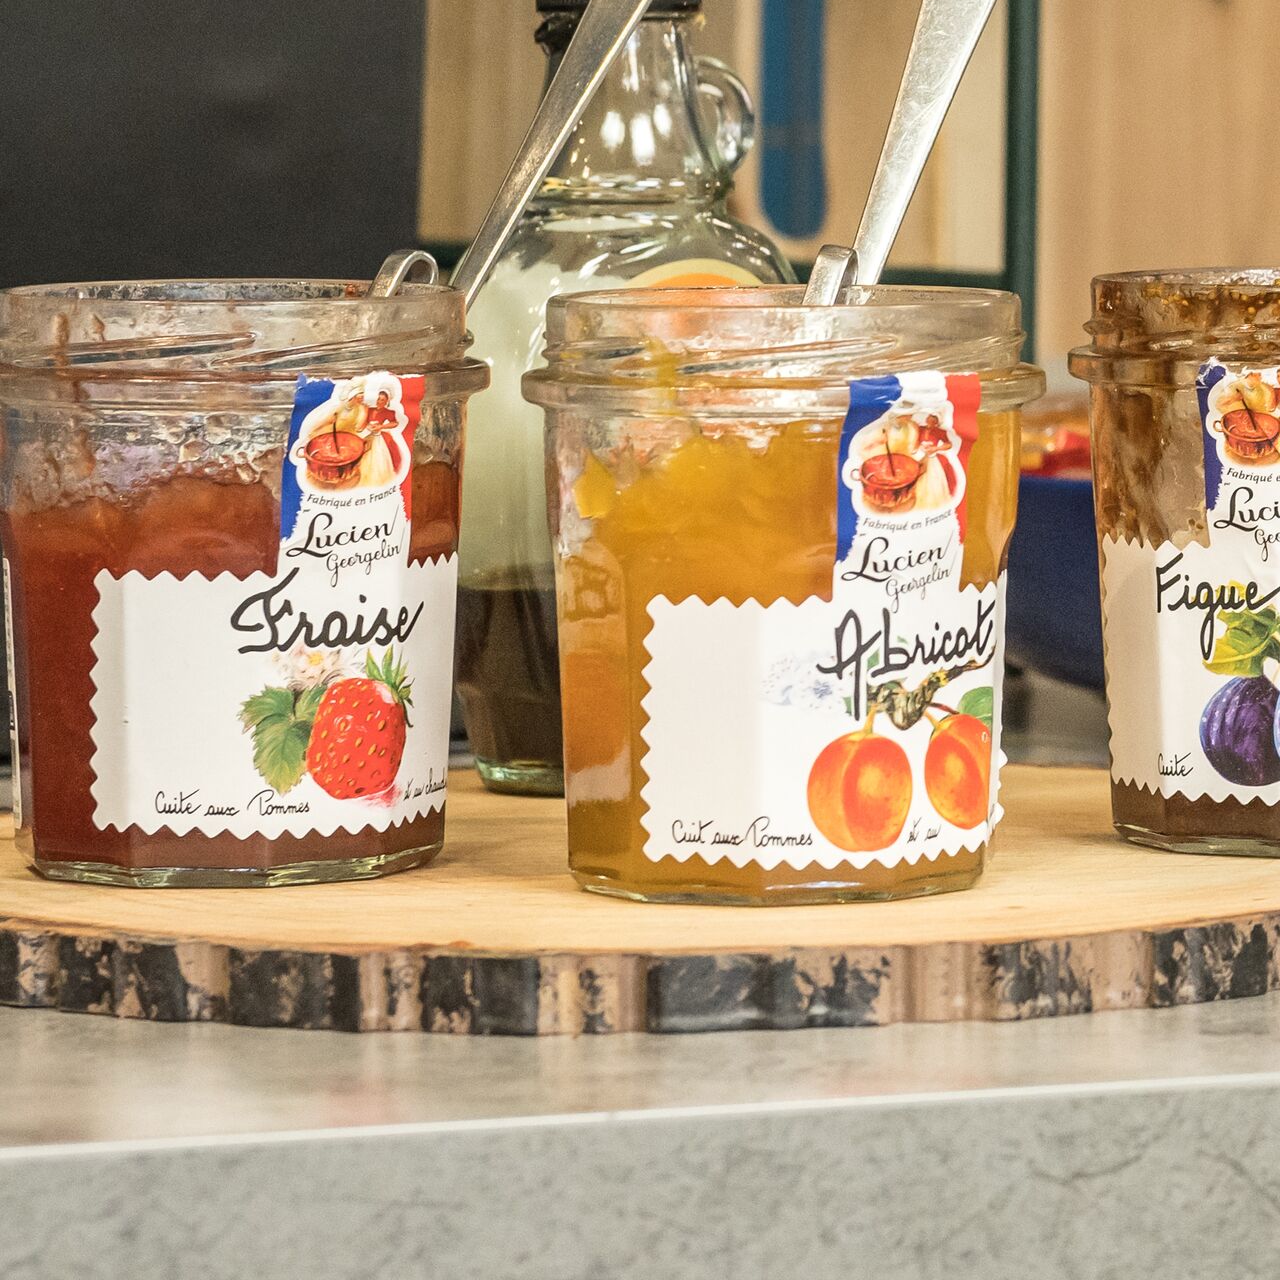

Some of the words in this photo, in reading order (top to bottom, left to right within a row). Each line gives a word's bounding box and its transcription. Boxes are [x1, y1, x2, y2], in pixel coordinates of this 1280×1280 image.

[1226, 466, 1273, 484] Fabriqué
[306, 493, 352, 509] Fabriqué
[354, 498, 367, 506] en
[369, 485, 397, 504] France
[925, 509, 952, 527] France
[286, 504, 399, 558] Lucien
[326, 526, 405, 588] Georgelin
[841, 530, 954, 583] Lucien
[885, 550, 958, 614] Georgelin
[230, 568, 425, 655] Fraise
[816, 599, 996, 721] Abricot
[1157, 752, 1194, 777] Cuite
[155, 789, 202, 815] Cuite
[203, 801, 240, 817] aux
[247, 789, 310, 817] Pommes
[671, 819, 714, 844] Cuit
[711, 831, 743, 846] aux
[742, 815, 813, 847] Pommes
